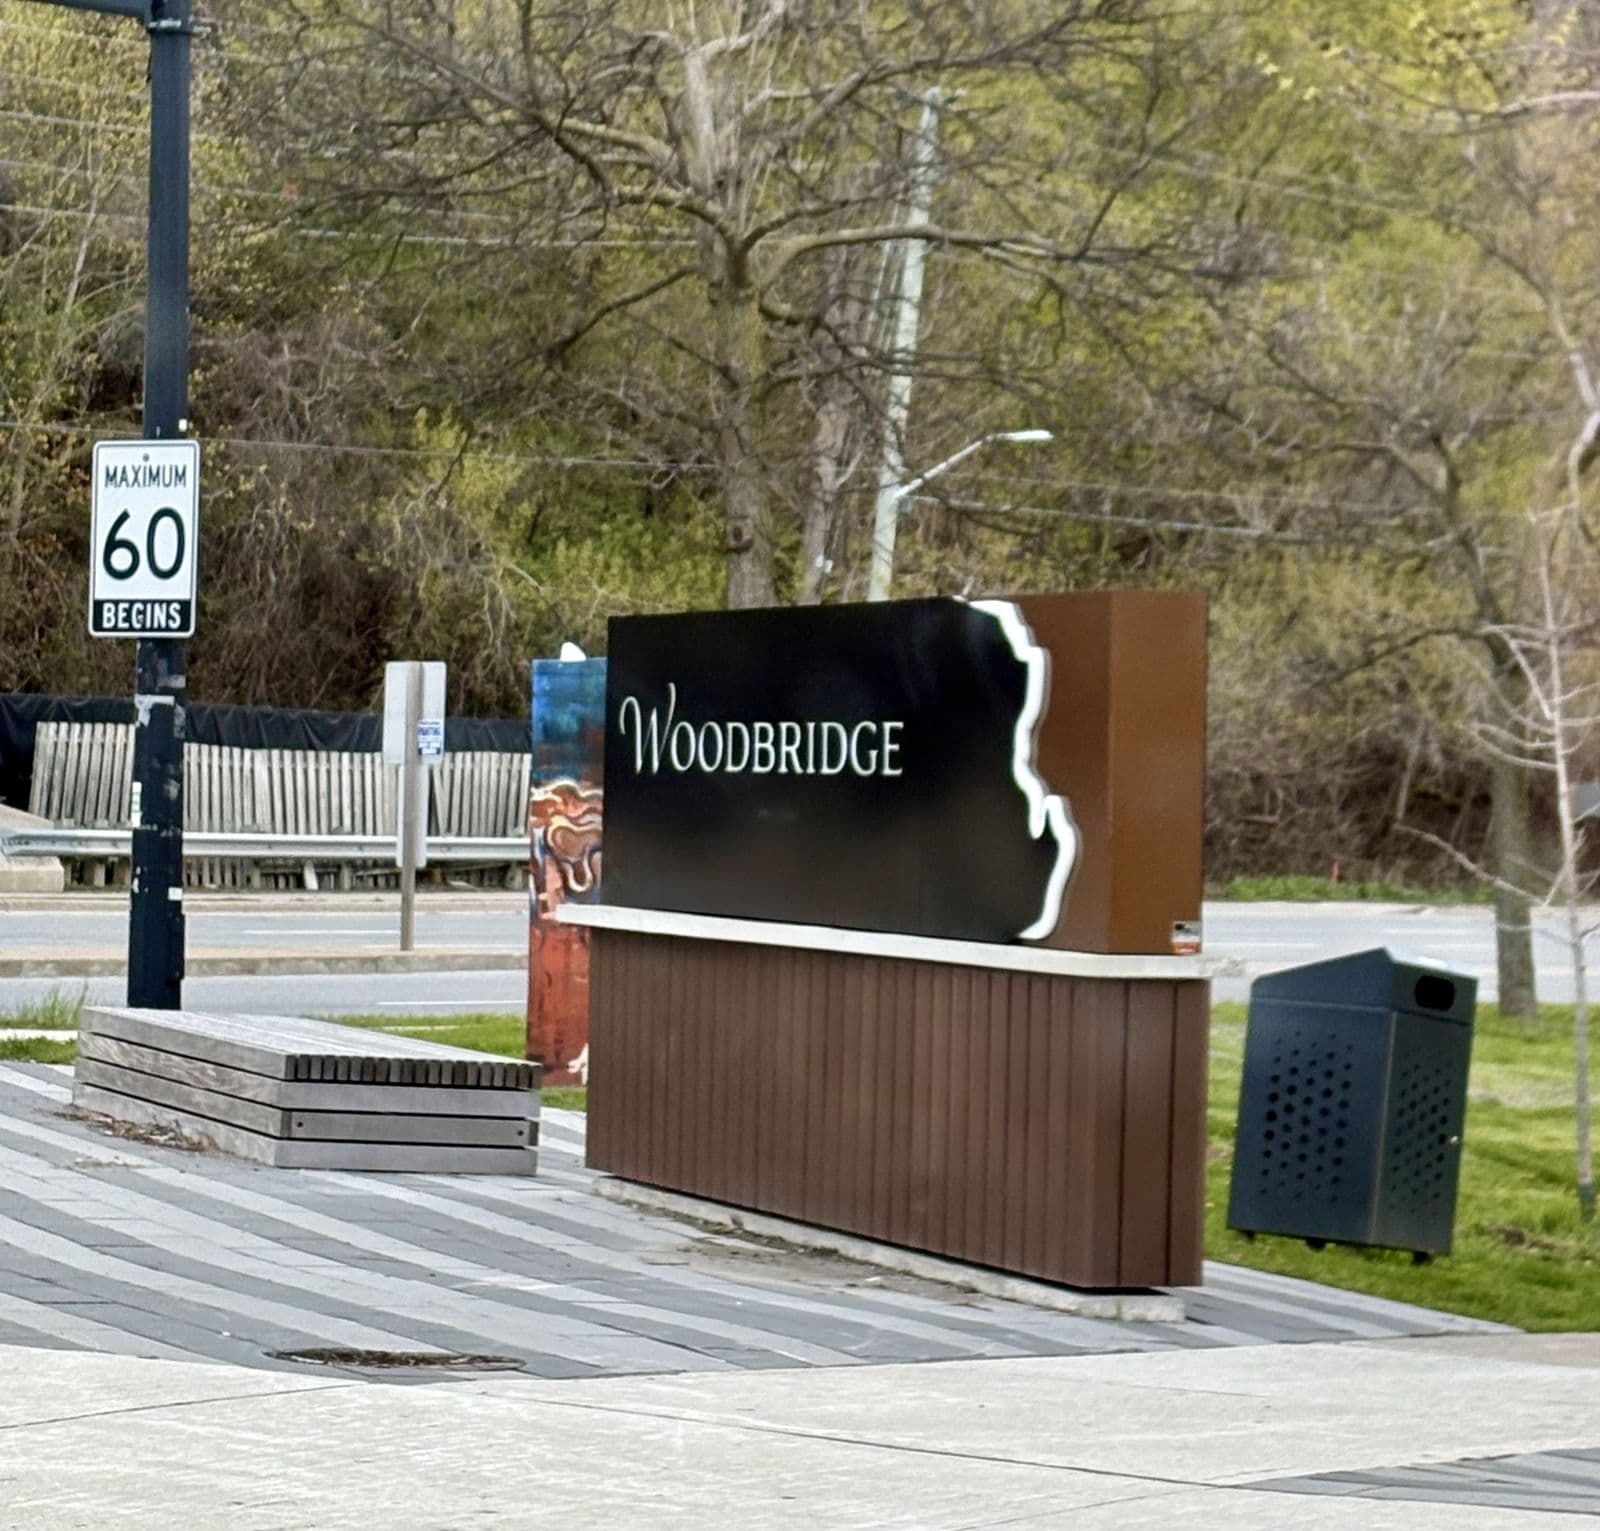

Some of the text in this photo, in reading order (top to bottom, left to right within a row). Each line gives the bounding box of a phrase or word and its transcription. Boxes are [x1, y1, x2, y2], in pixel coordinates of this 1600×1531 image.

[104, 463, 187, 489] MAXIMUM
[102, 506, 185, 580] 60
[101, 602, 182, 629] BEGINS
